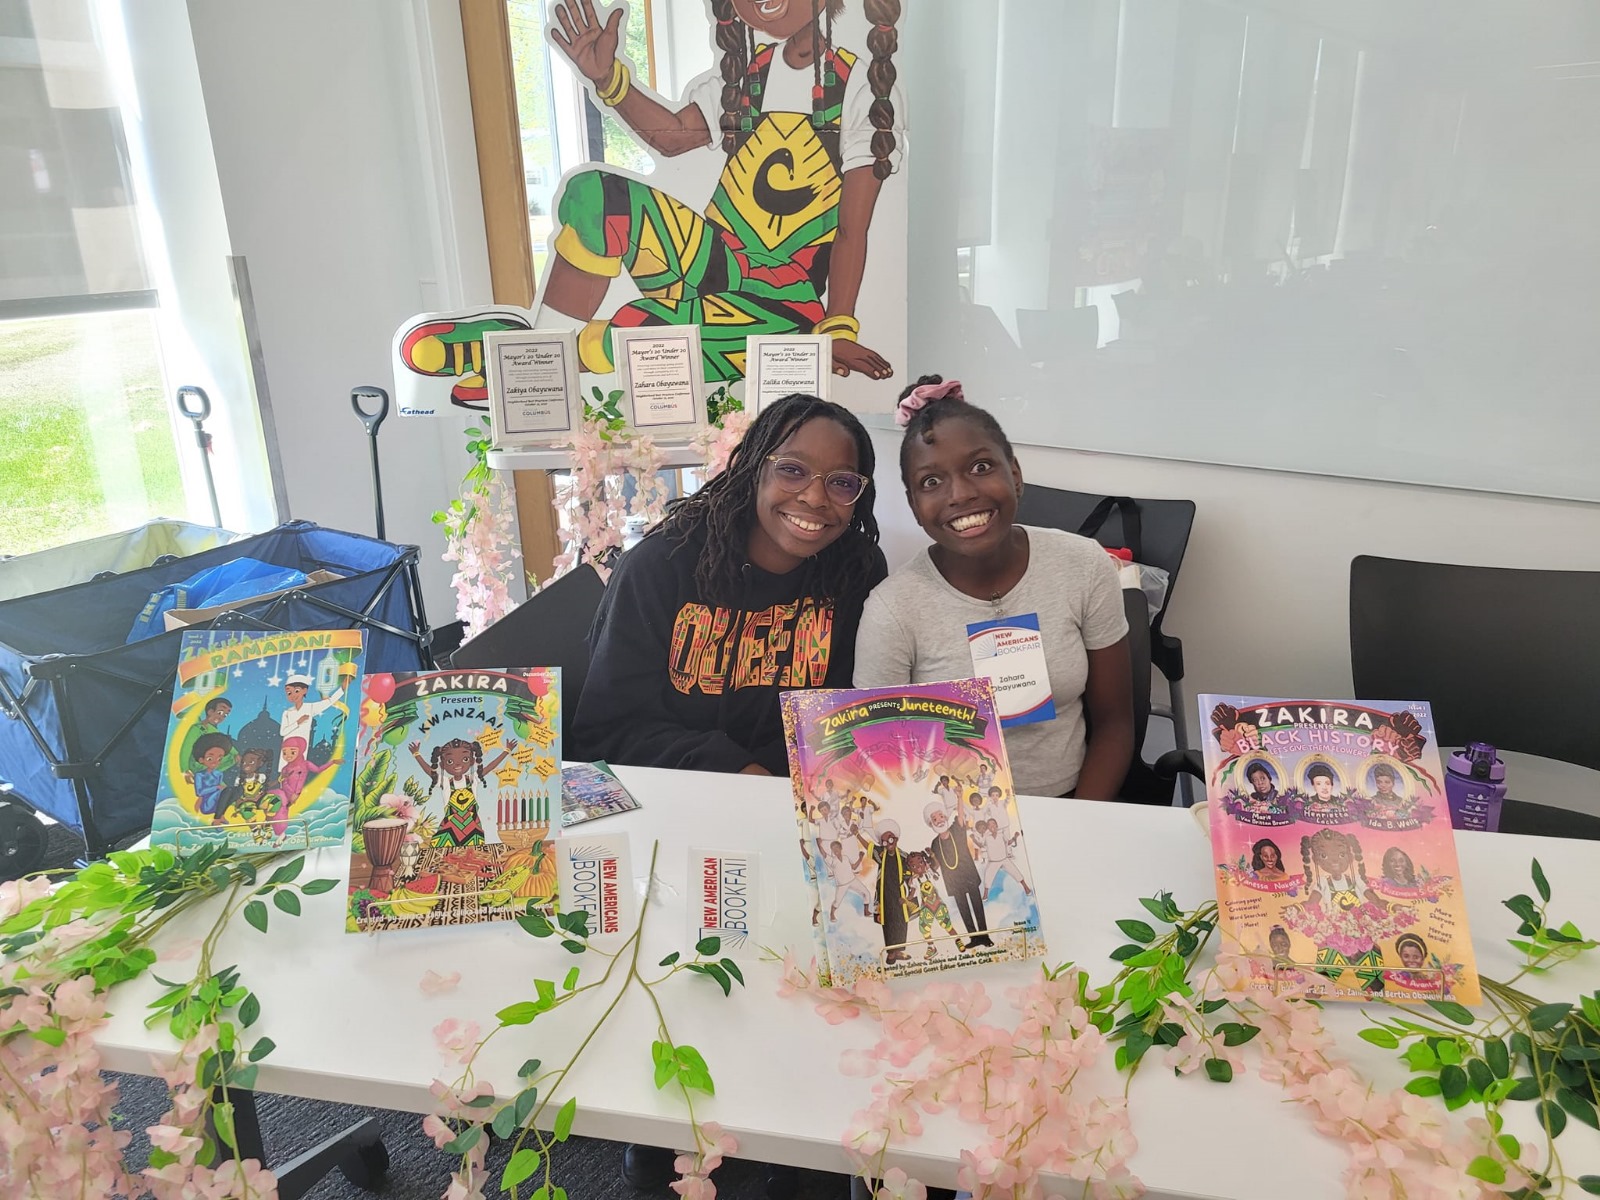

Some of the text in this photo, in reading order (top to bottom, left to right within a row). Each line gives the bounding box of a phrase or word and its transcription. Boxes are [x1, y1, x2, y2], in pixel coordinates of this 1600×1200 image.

[506, 386, 563, 395] Zakiya Obayuwana
[634, 380, 689, 389] Zahara Obayuwana
[995, 632, 1013, 640] NEW
[996, 635, 1039, 648] AMERICANS
[182, 635, 252, 662] ZAKIRA
[210, 634, 332, 668] RAMADAN!
[668, 596, 834, 694] QUEEN
[997, 642, 1041, 656] BOOKFAIR
[415, 674, 508, 697] ZAKIRA
[999, 674, 1025, 684] Zahara
[441, 695, 483, 704] Presents
[418, 707, 504, 734] KWANZAA!
[820, 698, 976, 736] Zakira PRESENTS Juneteenth!
[1255, 707, 1374, 730] ZAKIRA
[1293, 722, 1334, 730] PRESENTS
[1236, 729, 1400, 756] BLACK HISTORY
[1289, 744, 1308, 752] GIVE
[1309, 744, 1330, 752] THEM
[1331, 746, 1371, 758] FLOWERS!
[1304, 810, 1350, 819] Henrietta
[1369, 818, 1419, 829] Ida B. Wells
[1239, 874, 1269, 890] Vanessa
[602, 858, 619, 934] NEW AMERICANS
[1225, 897, 1262, 907] Coloring pages!
[704, 907, 717, 928] NEW
[1434, 907, 1452, 918] More
[1428, 926, 1452, 939] Heroes
[876, 964, 899, 973] Ceated
[1385, 990, 1411, 999] Bertha
